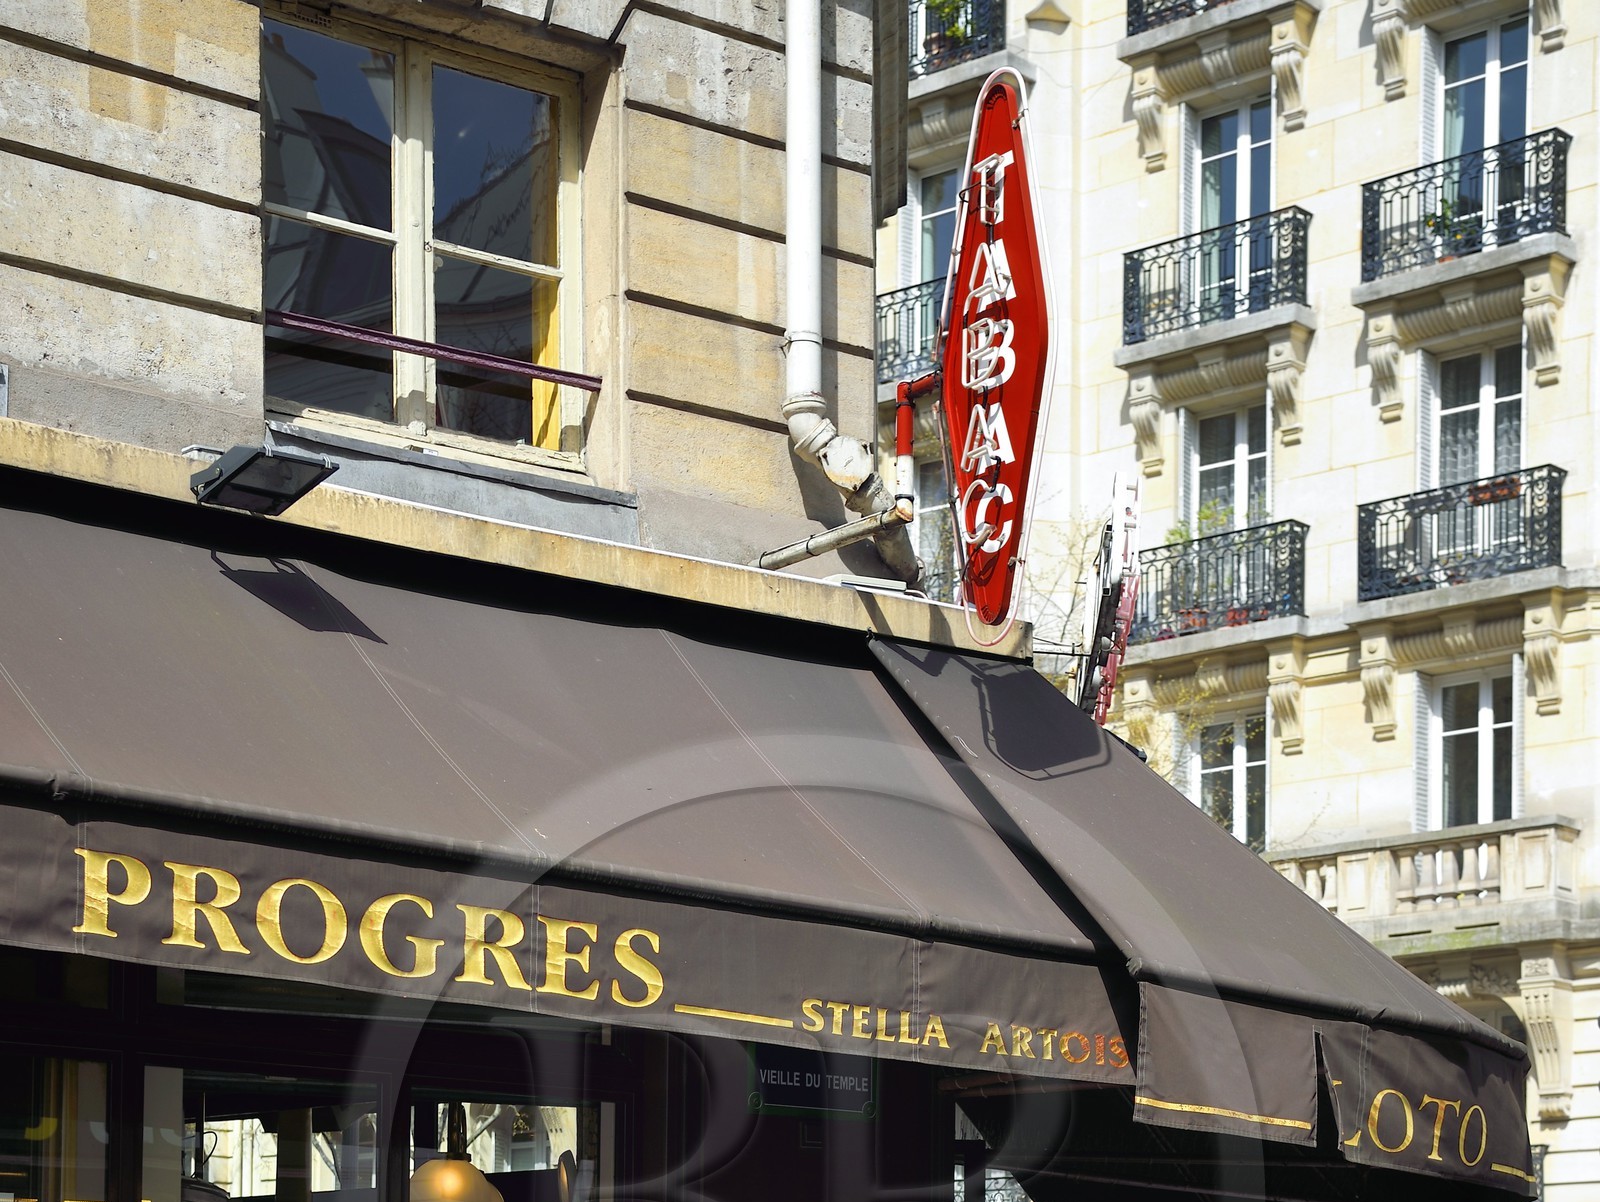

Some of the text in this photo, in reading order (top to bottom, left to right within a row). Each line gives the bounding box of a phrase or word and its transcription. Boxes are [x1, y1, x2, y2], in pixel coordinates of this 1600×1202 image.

[961, 150, 1017, 554] TABAC
[72, 847, 664, 1008] PROGRES
[760, 1069, 869, 1092] VIEILLE DU TEMPLE
[801, 998, 1130, 1069] STELLA ARTOIS
